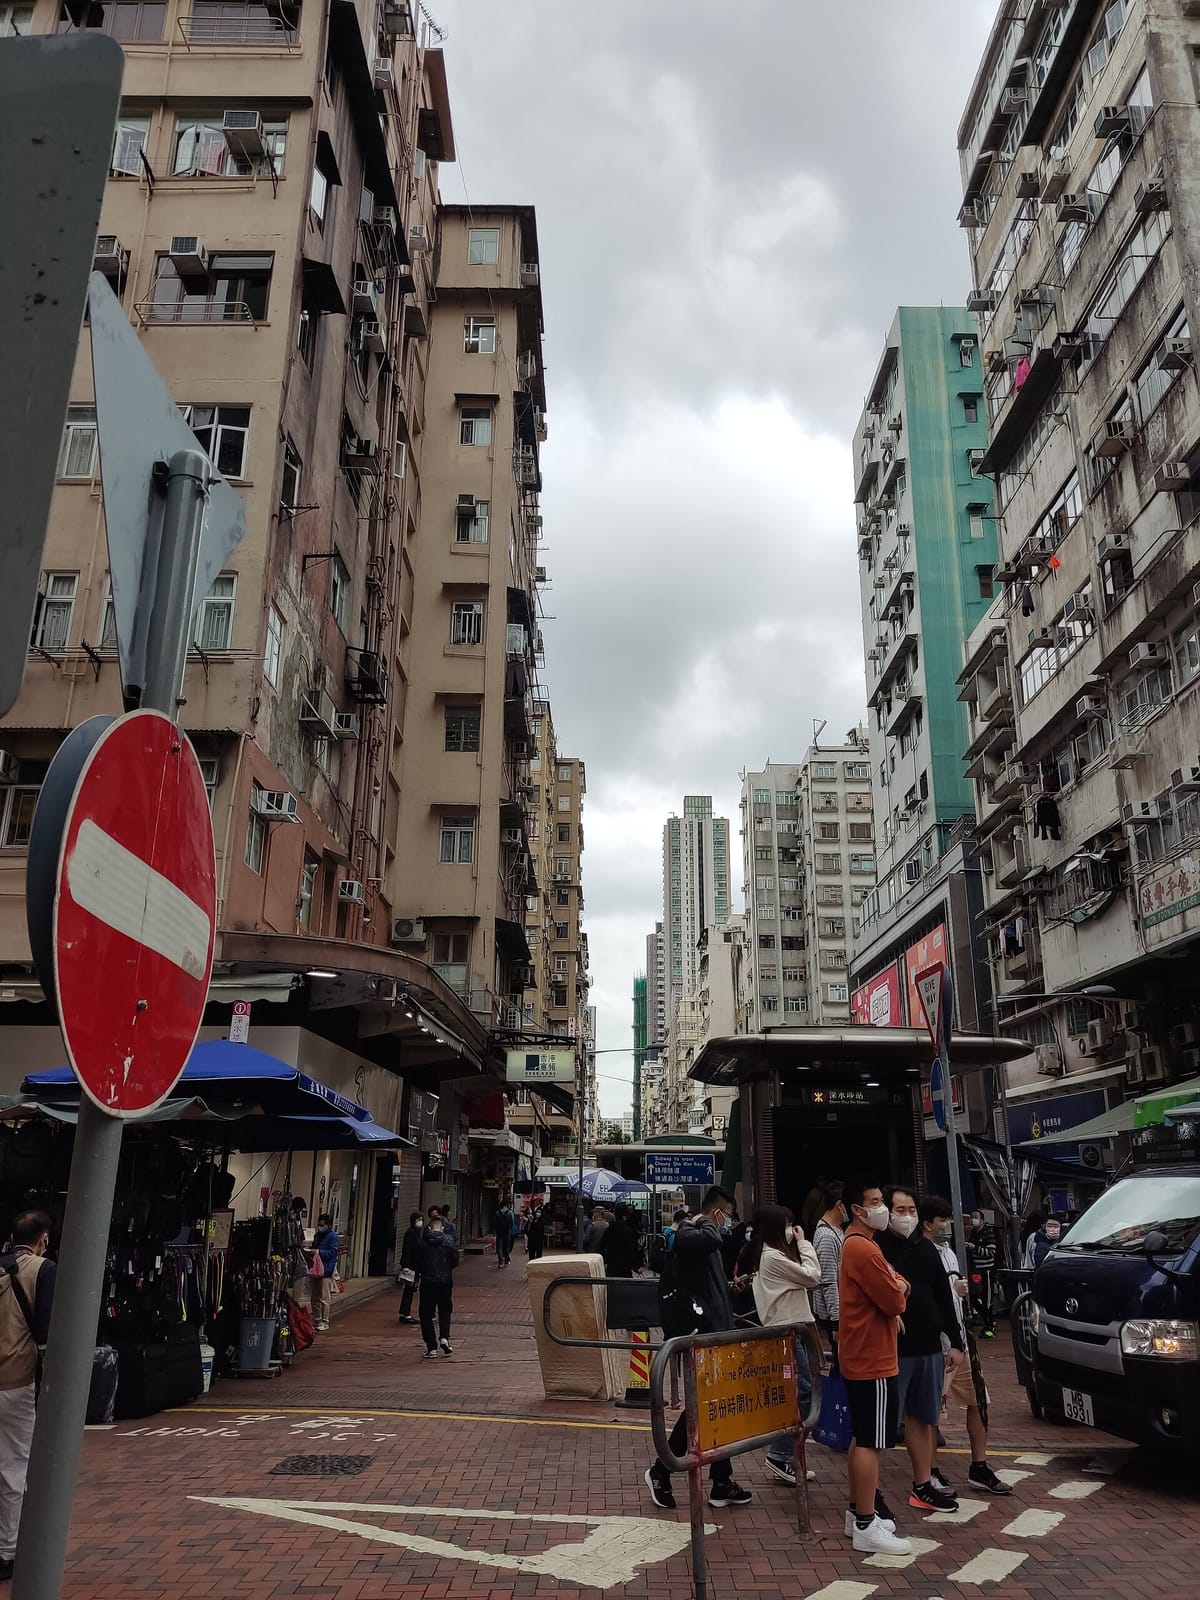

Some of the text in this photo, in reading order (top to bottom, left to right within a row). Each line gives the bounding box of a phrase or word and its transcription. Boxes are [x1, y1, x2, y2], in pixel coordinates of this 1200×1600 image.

[924, 979, 935, 993] GIVE
[926, 993, 936, 1006] WAY
[1066, 1403, 1090, 1424] 3931
